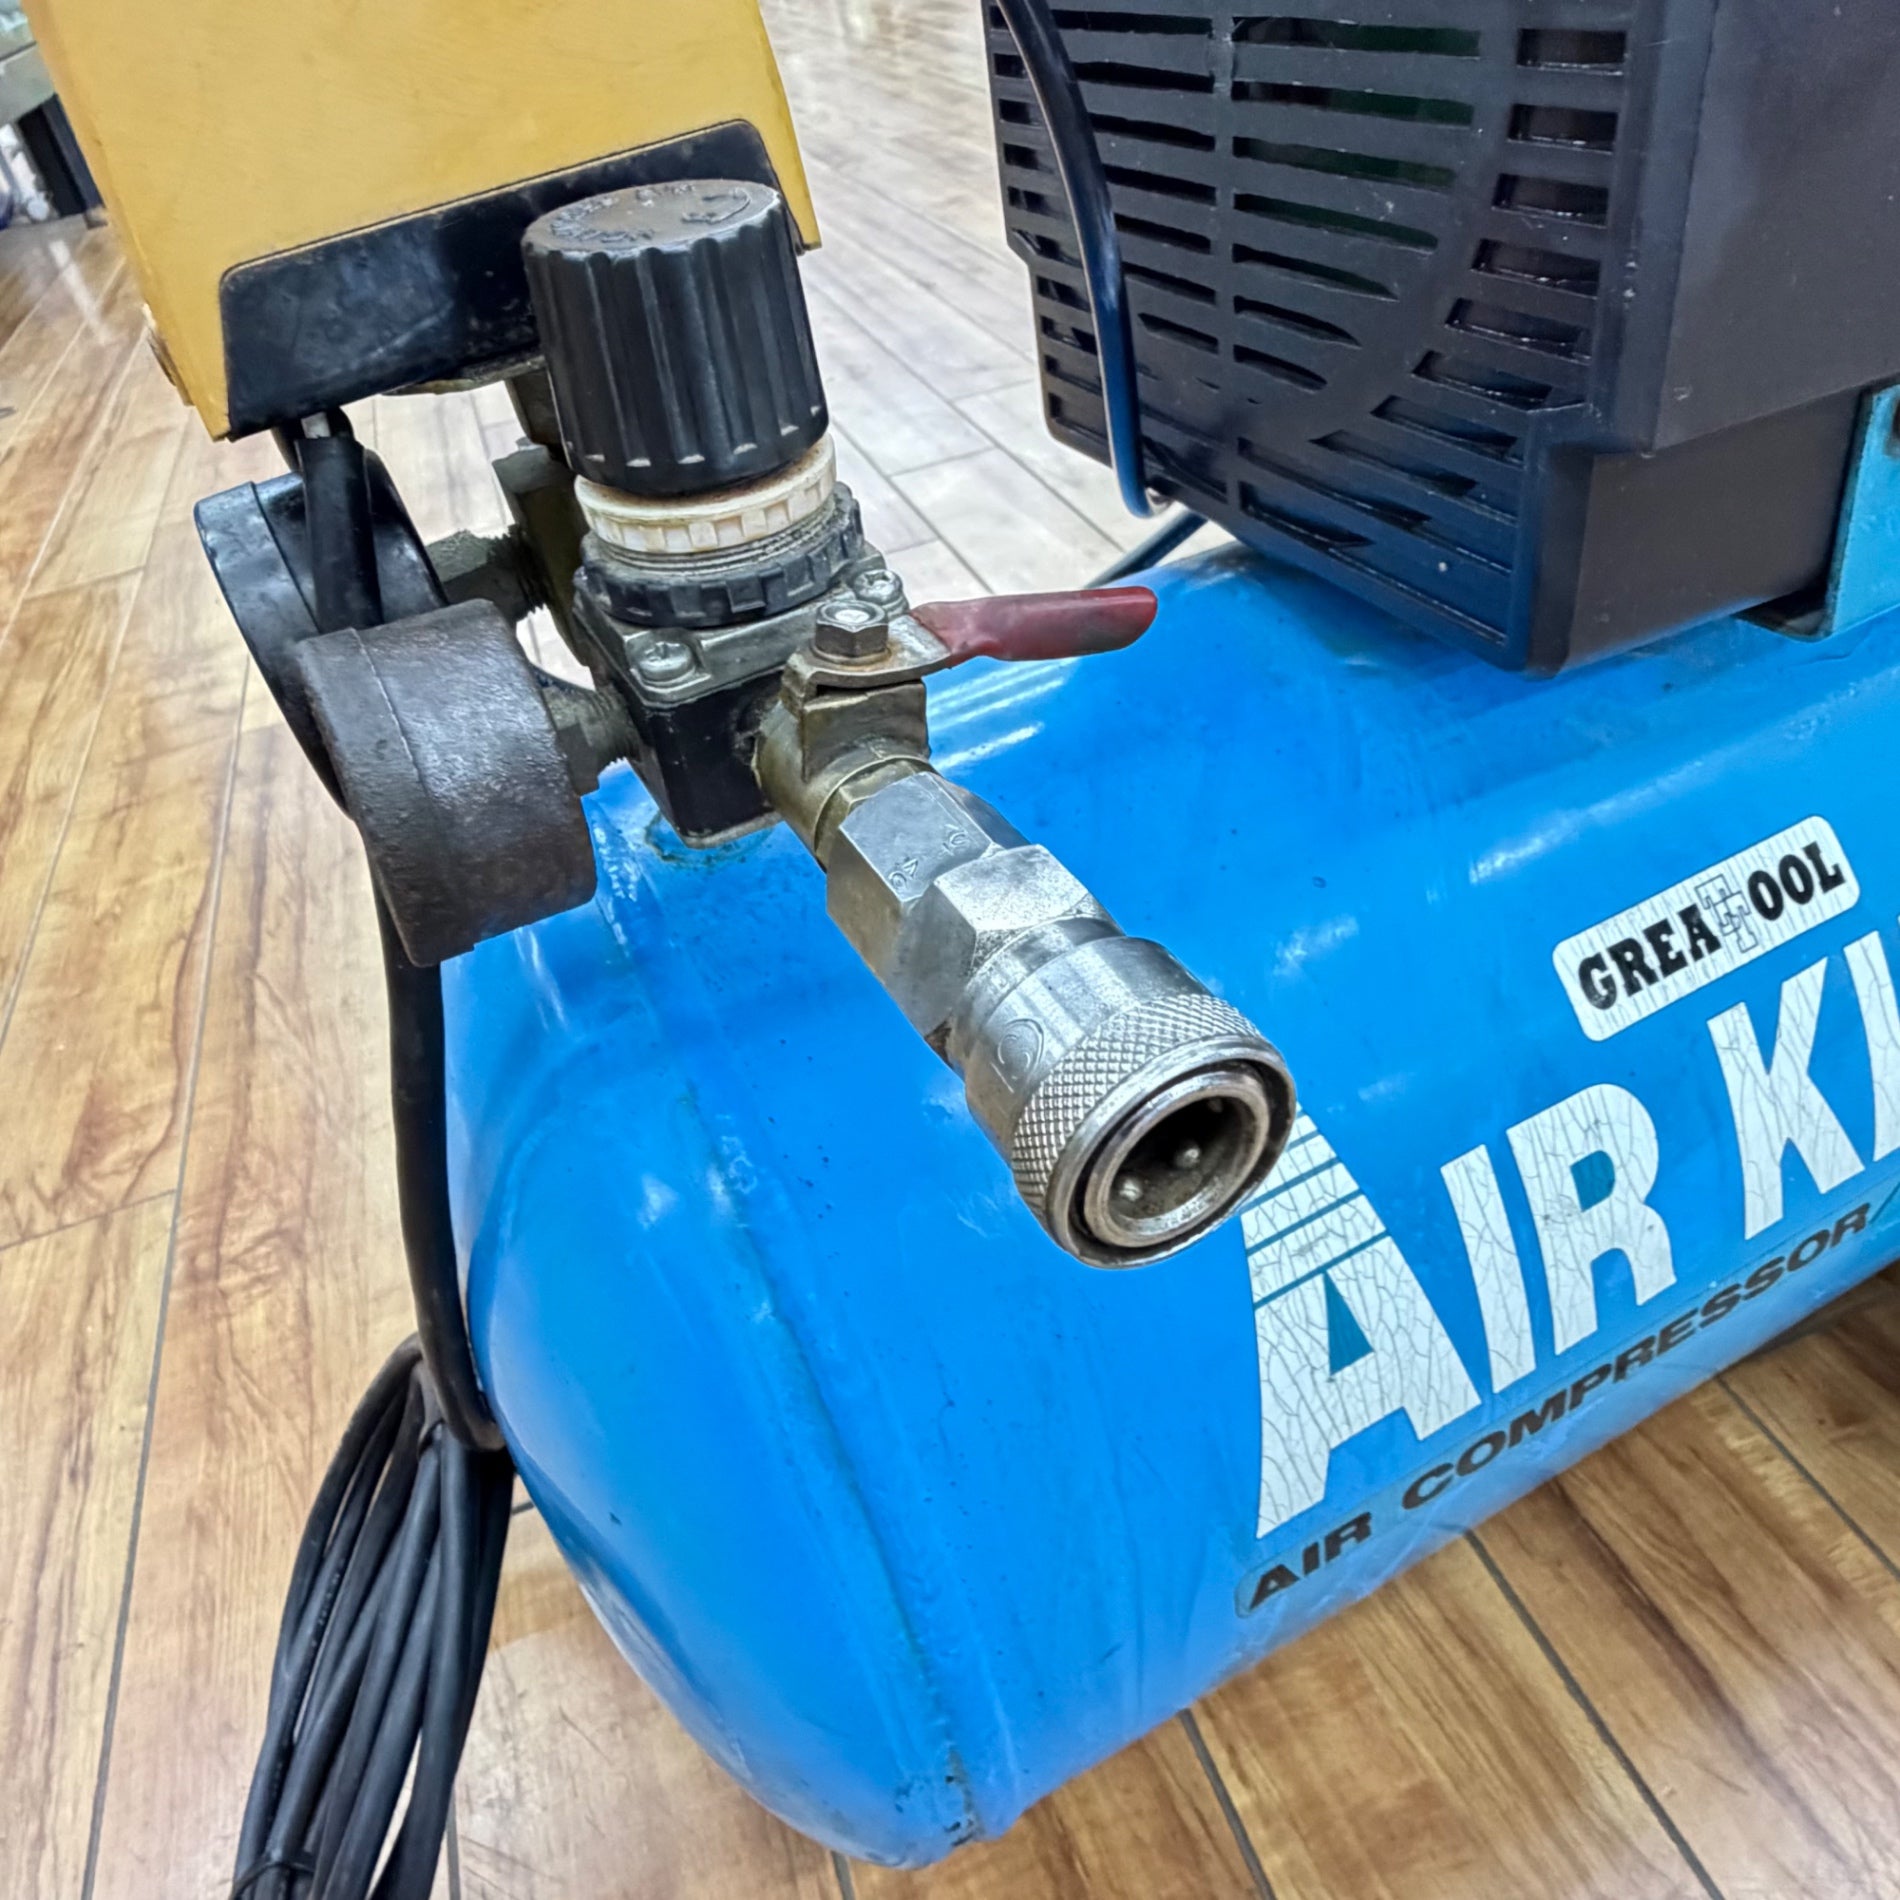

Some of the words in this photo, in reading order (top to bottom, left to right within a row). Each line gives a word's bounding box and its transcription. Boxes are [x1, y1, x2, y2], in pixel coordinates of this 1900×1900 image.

[1240, 1083, 1677, 1539] AIR
[1707, 912, 1900, 1240] KI
[1248, 1511, 1372, 1612] AIR
[1401, 1202, 1871, 1512] COMPRESSOR
